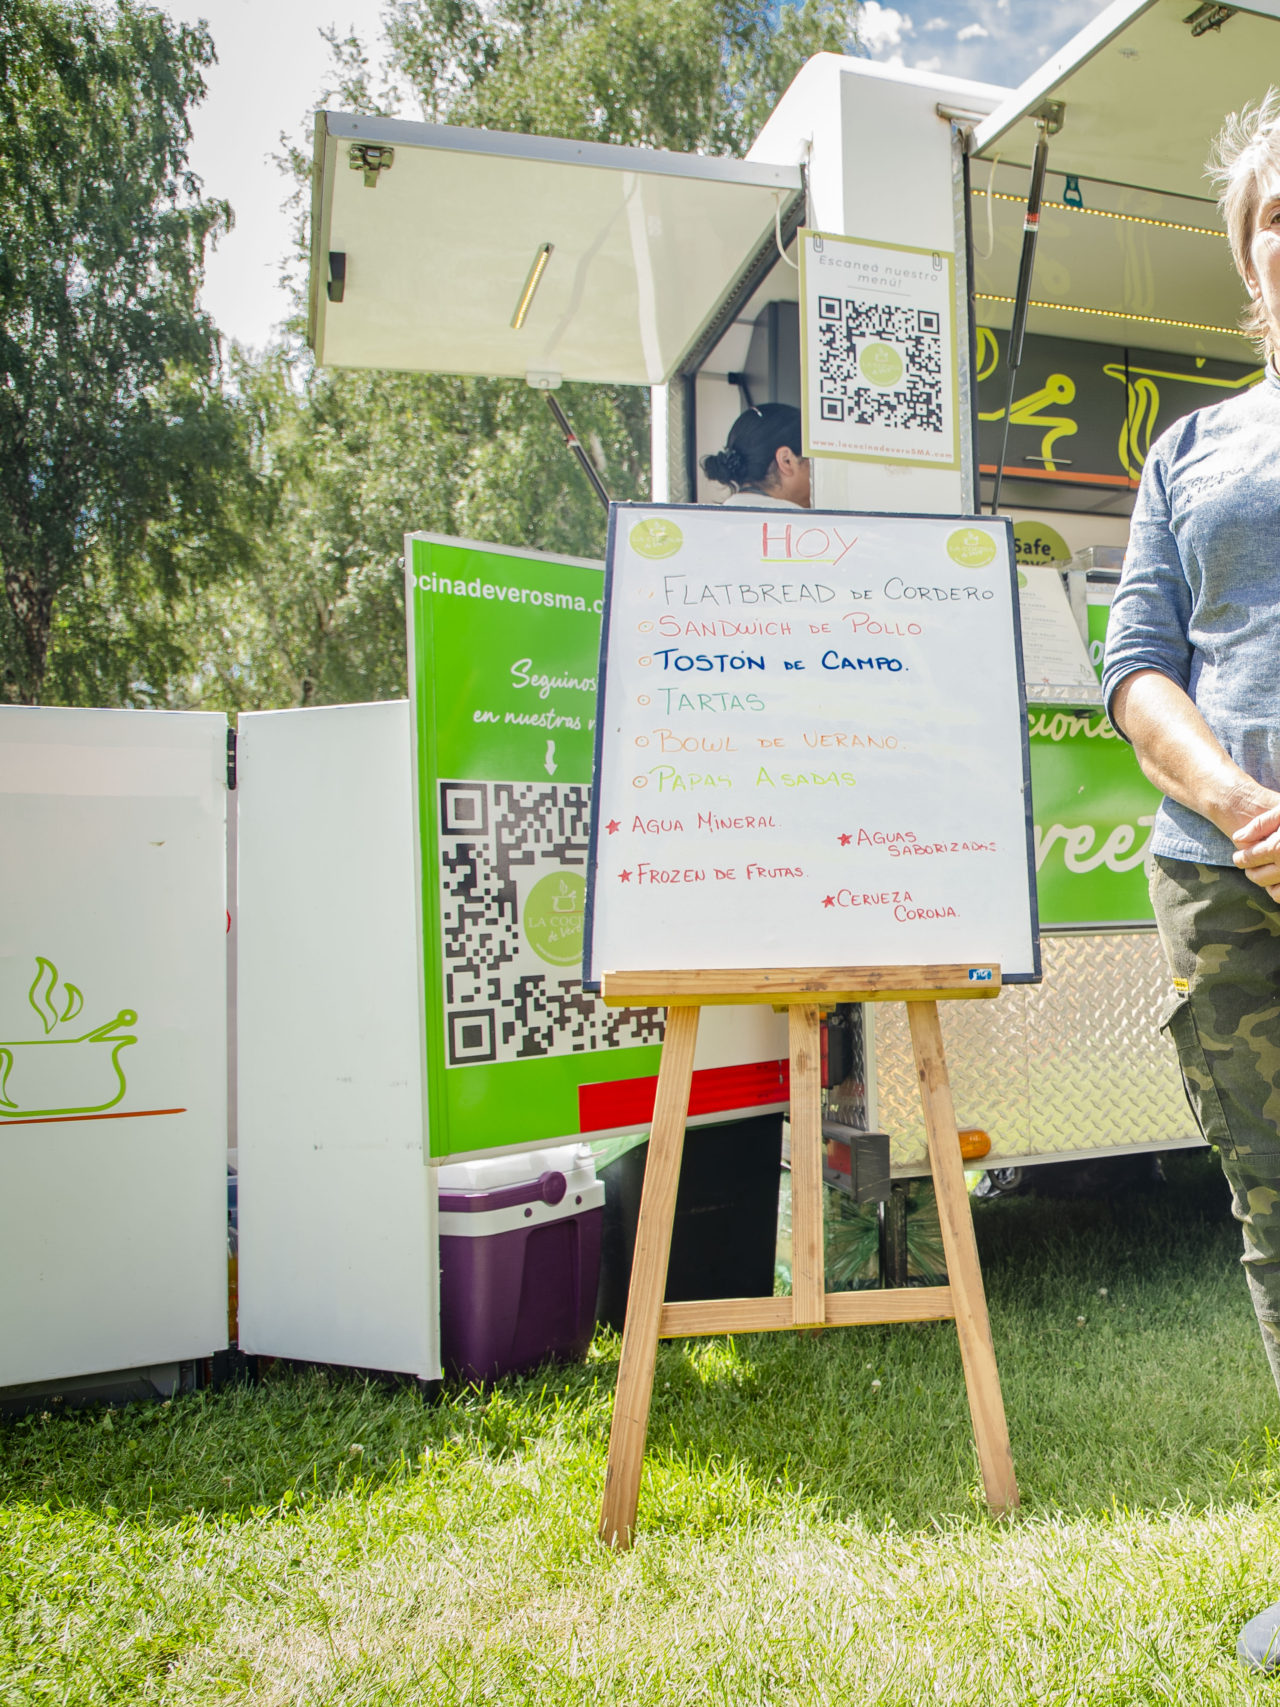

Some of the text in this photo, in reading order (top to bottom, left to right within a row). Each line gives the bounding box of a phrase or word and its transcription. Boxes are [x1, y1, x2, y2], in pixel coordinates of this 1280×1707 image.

[857, 273, 903, 288] menú!
[884, 264, 939, 282] nuestro
[762, 522, 859, 566] HOY
[1014, 538, 1051, 556] Safe
[663, 574, 836, 607] FLATBREAD
[884, 577, 995, 601] CORDERO
[842, 612, 923, 636] POLLO
[821, 650, 909, 673] CAMPO.
[510, 658, 597, 699] Seguinos
[657, 687, 766, 716] TARTAS
[473, 709, 500, 723] en
[504, 708, 581, 731] nuestras
[652, 728, 739, 753] BOWL
[649, 764, 857, 793] PAPAS ASADAS
[631, 815, 684, 834] AGUA
[856, 828, 917, 846] AGUAS
[637, 863, 706, 884] FROZEN
[714, 867, 736, 881] DE
[836, 888, 913, 907] CERVEZA
[528, 916, 547, 928] LA
